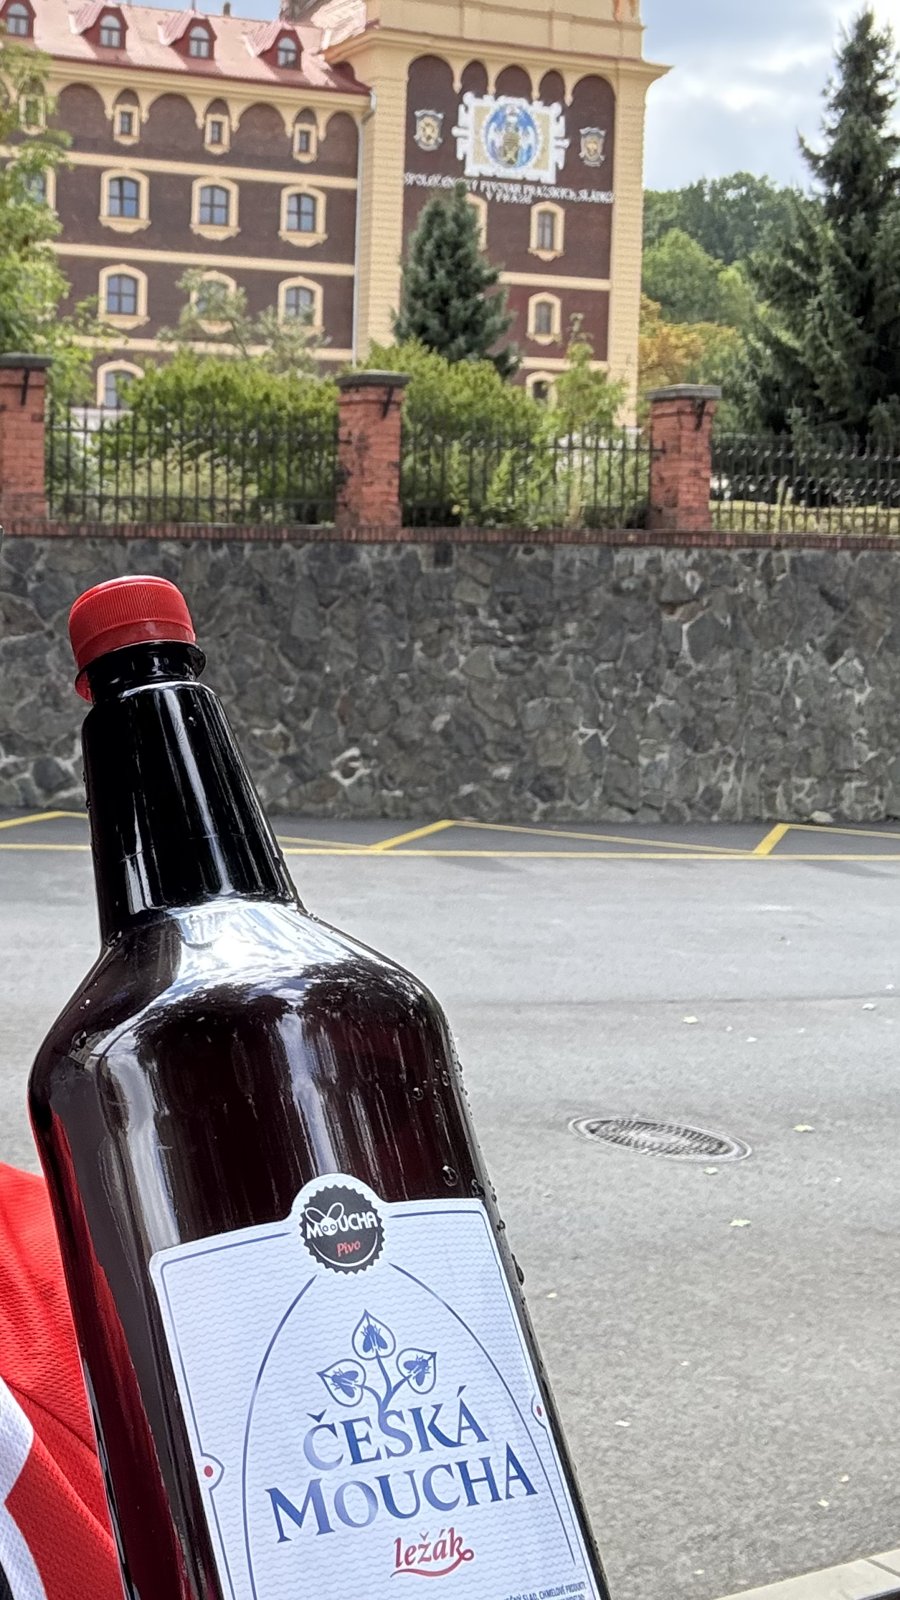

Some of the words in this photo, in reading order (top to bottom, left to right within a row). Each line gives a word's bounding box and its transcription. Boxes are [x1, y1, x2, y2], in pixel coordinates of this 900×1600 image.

[305, 1211, 379, 1240] MOUCHA
[302, 1385, 490, 1471] ČESKÁ
[264, 1441, 539, 1544] MOUCHA
[390, 1527, 475, 1577] ležák
